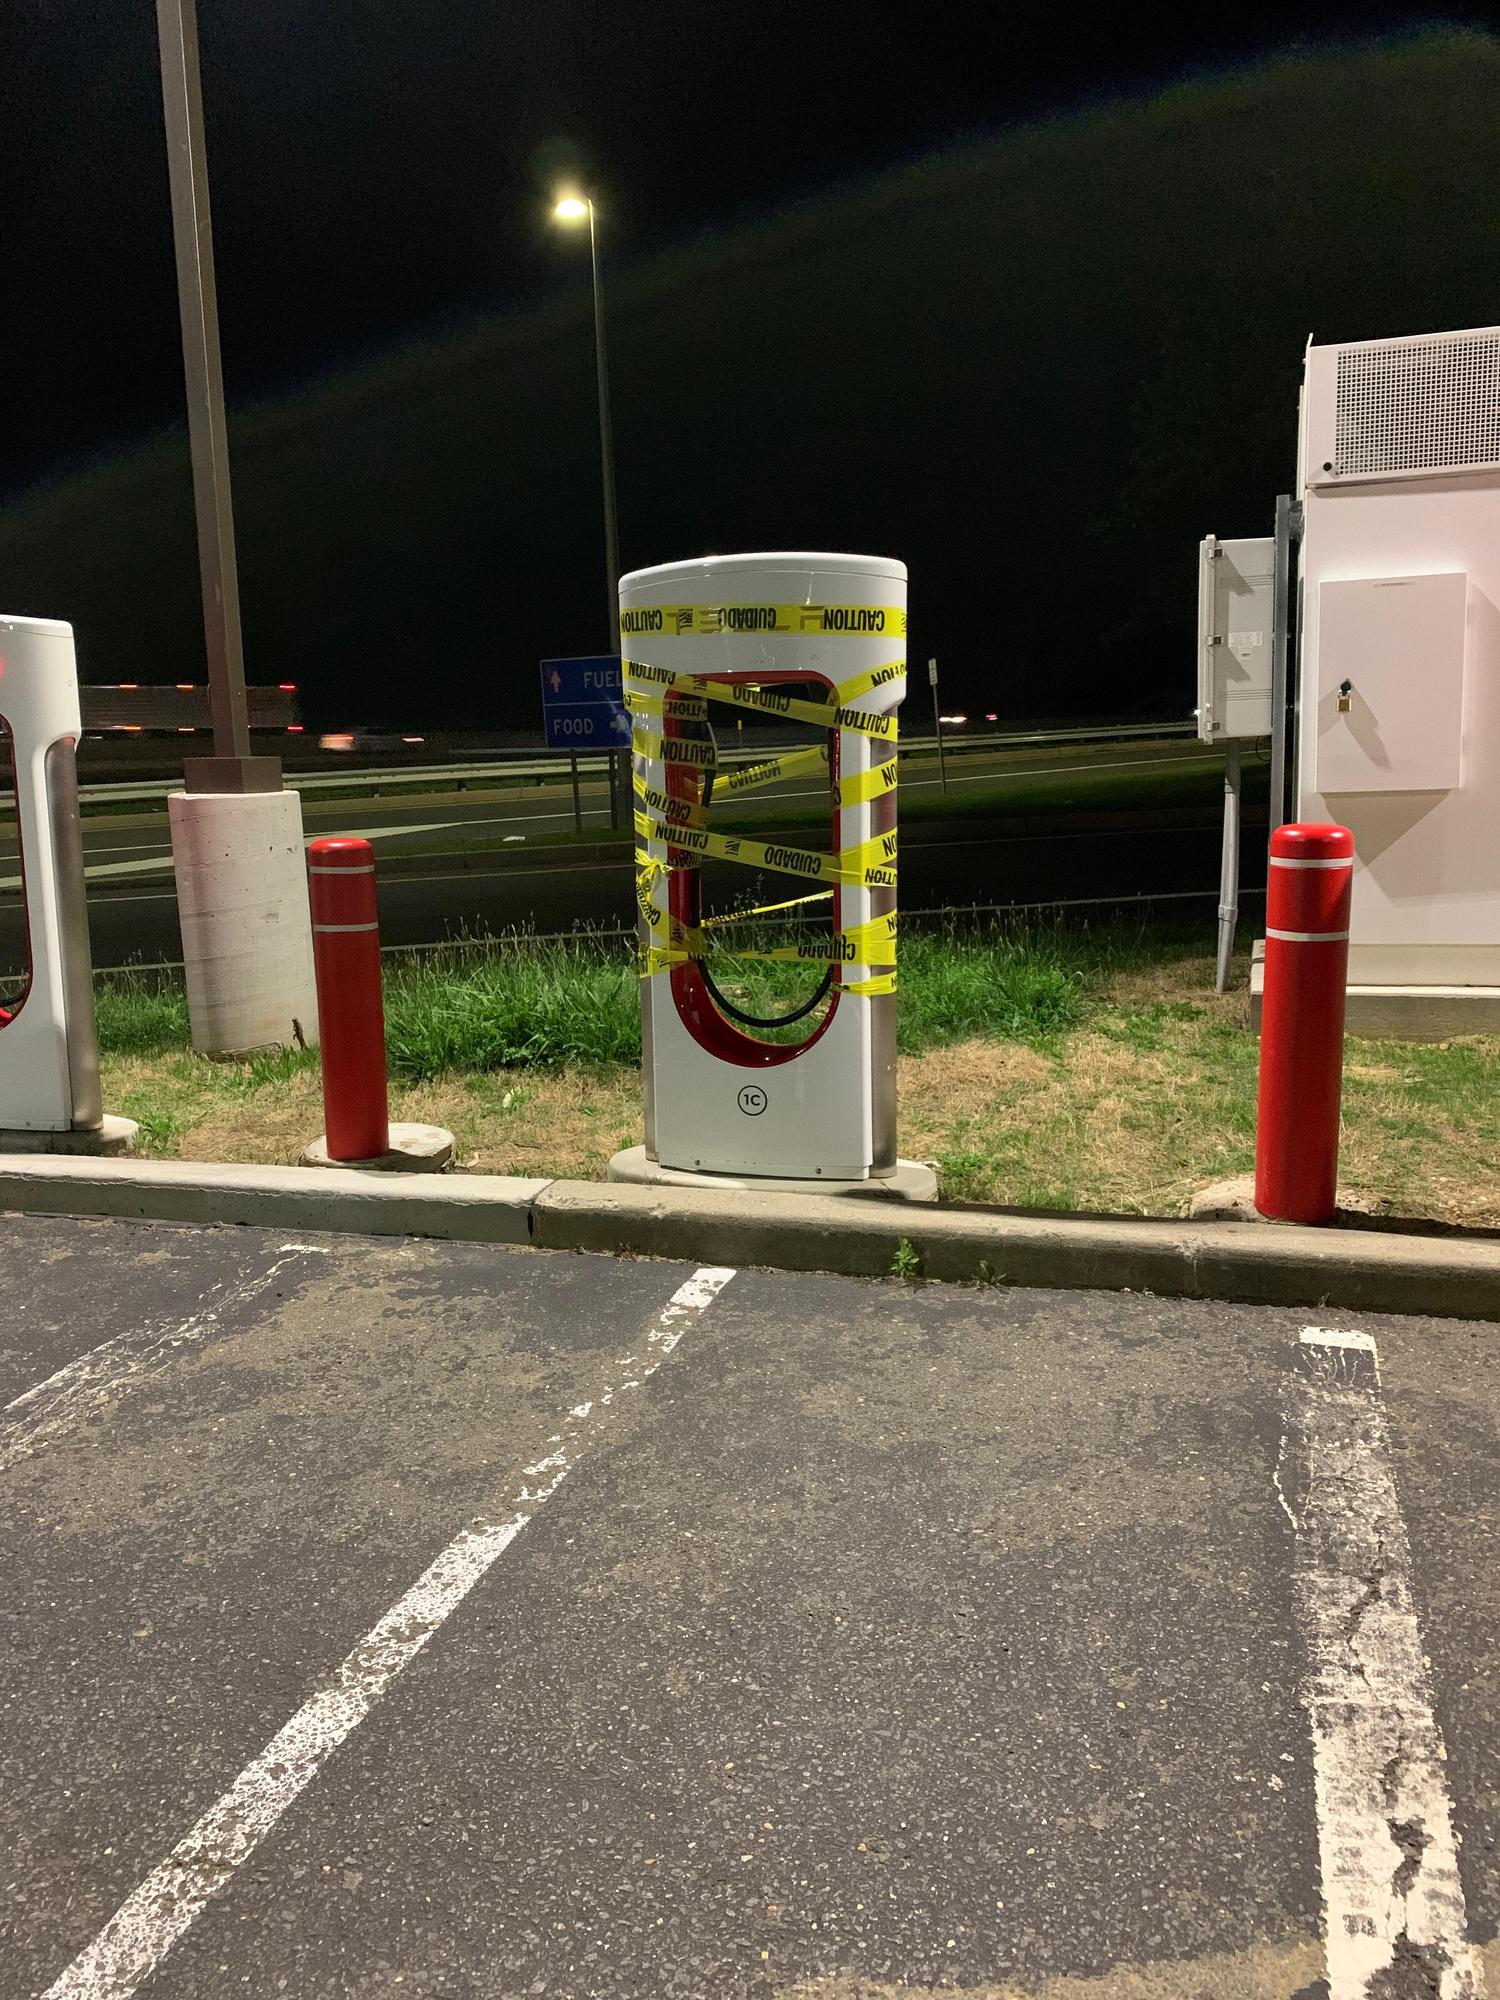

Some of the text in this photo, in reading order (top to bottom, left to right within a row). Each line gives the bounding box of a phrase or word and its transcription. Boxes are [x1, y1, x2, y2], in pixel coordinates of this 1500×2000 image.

[621, 610, 662, 632] CAUTION
[718, 607, 776, 629] CUIDADO
[824, 609, 885, 631] CAUTION
[583, 670, 622, 689] FUEL
[628, 661, 676, 685] CAUTION
[553, 718, 594, 735] FOOD
[834, 707, 890, 734] CAUTION
[660, 740, 716, 765] CAUTION
[644, 788, 691, 820] CAUTION
[655, 824, 709, 849] CAUTION
[765, 846, 822, 875] CUIDADO
[744, 1094, 761, 1107] 1C
